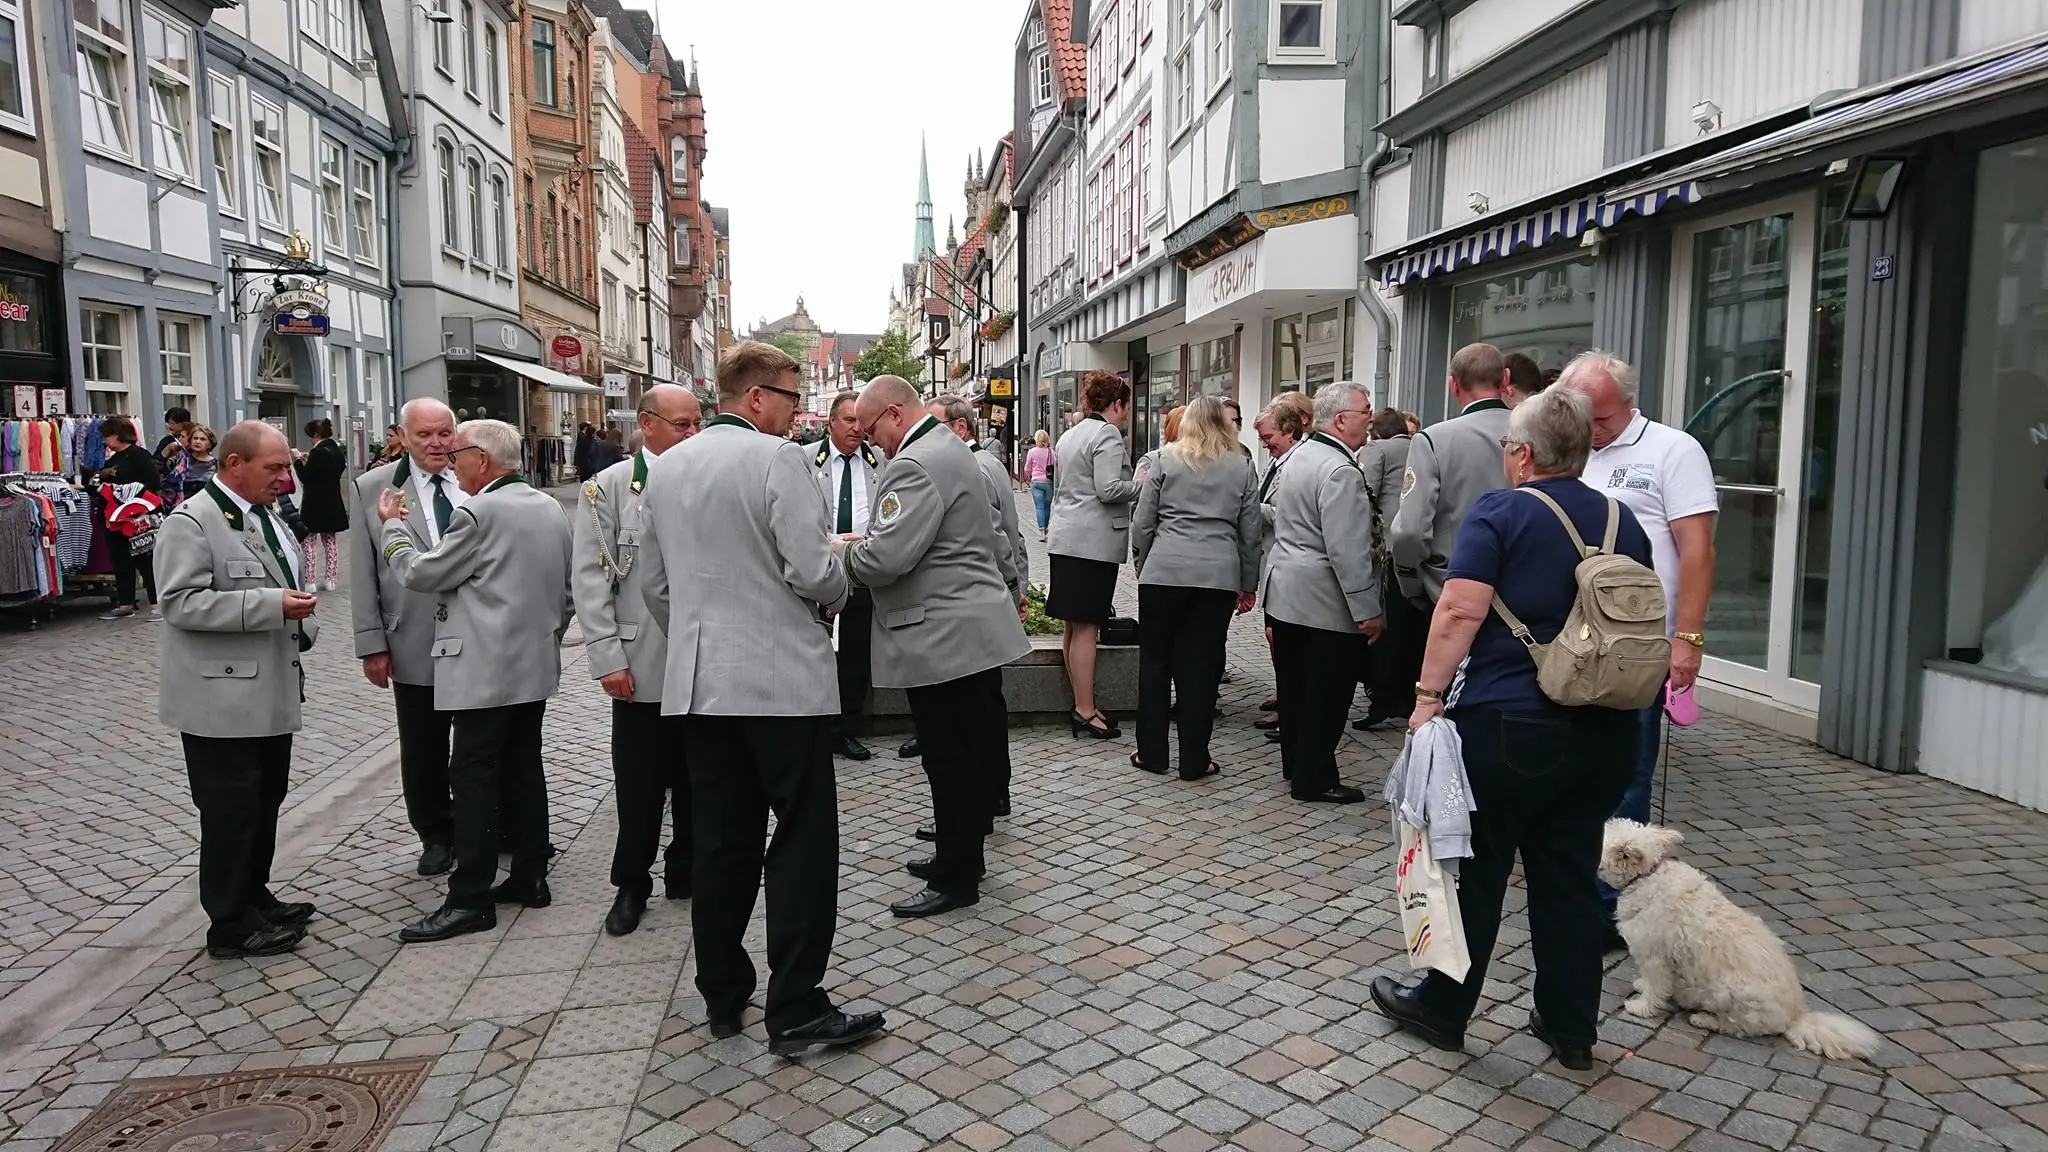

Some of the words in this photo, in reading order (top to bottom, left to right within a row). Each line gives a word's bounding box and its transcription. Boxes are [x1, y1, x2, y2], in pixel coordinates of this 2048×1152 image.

[1875, 258, 1889, 276] 23
[277, 294, 293, 304] Zur
[298, 291, 324, 306] Krone
[21, 400, 31, 412] 4
[50, 403, 58, 415] 5
